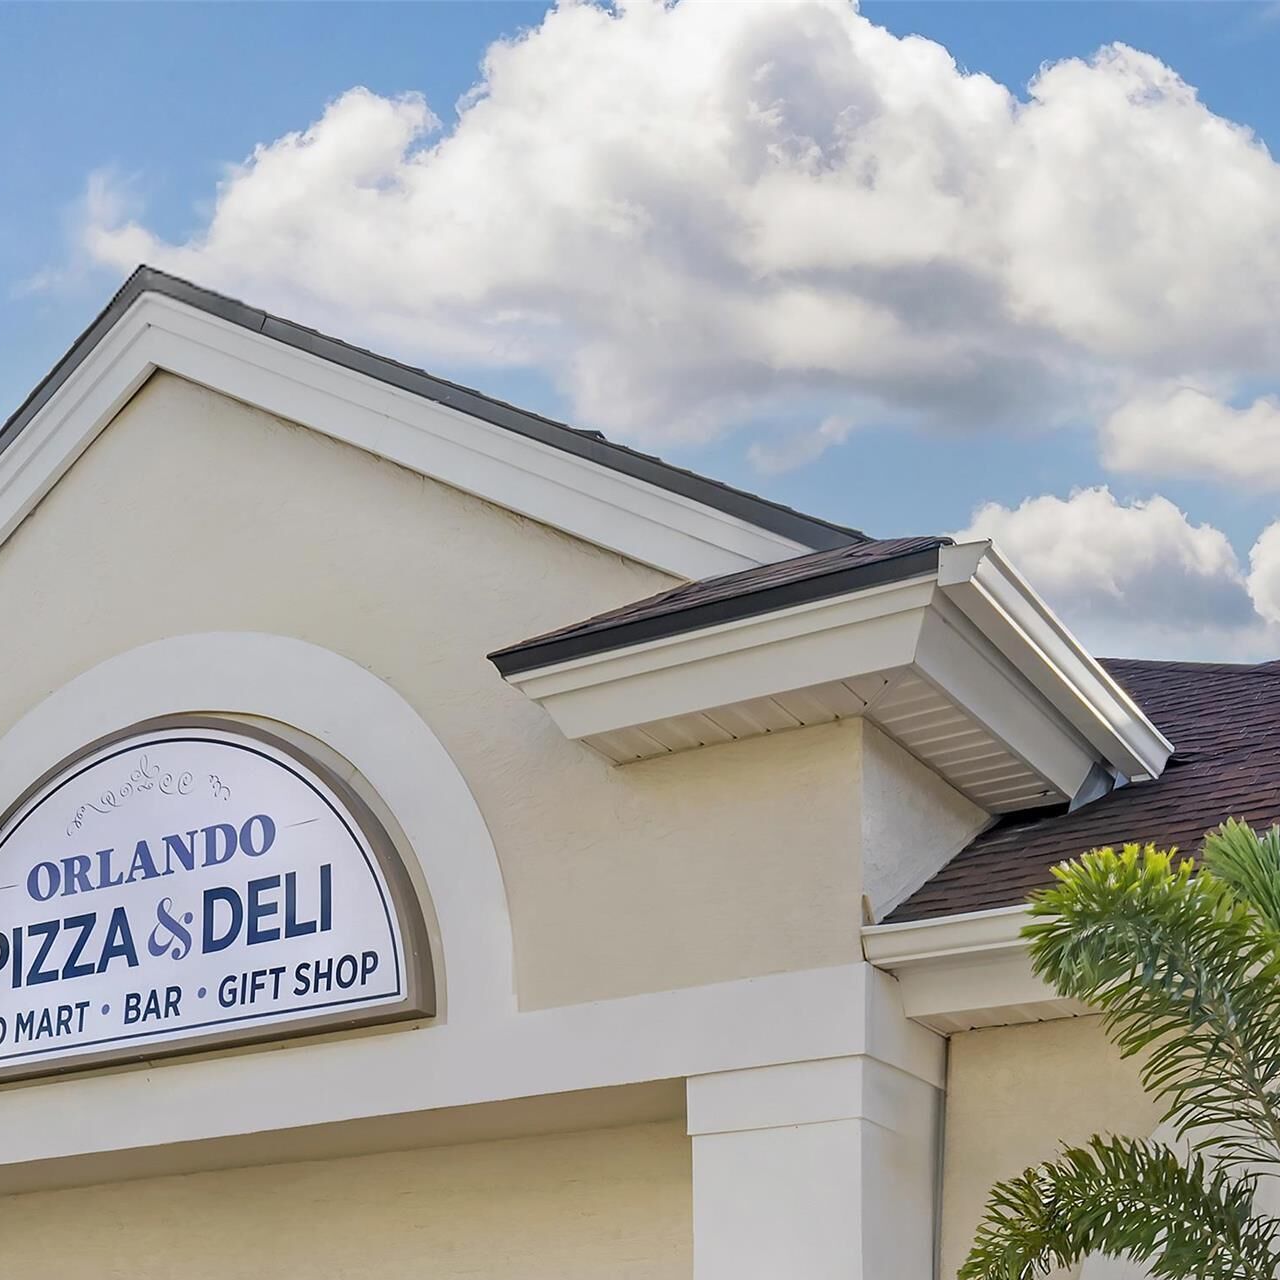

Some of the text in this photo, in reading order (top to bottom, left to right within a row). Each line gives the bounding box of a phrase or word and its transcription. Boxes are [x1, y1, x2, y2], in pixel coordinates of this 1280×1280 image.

[27, 814, 276, 902] ORLANDO
[147, 896, 195, 961] &
[202, 863, 332, 955] DELI
[15, 1001, 90, 1042] MART
[123, 985, 183, 1025] BAR
[218, 966, 287, 1008] GIFT
[294, 950, 380, 997] SHOP
